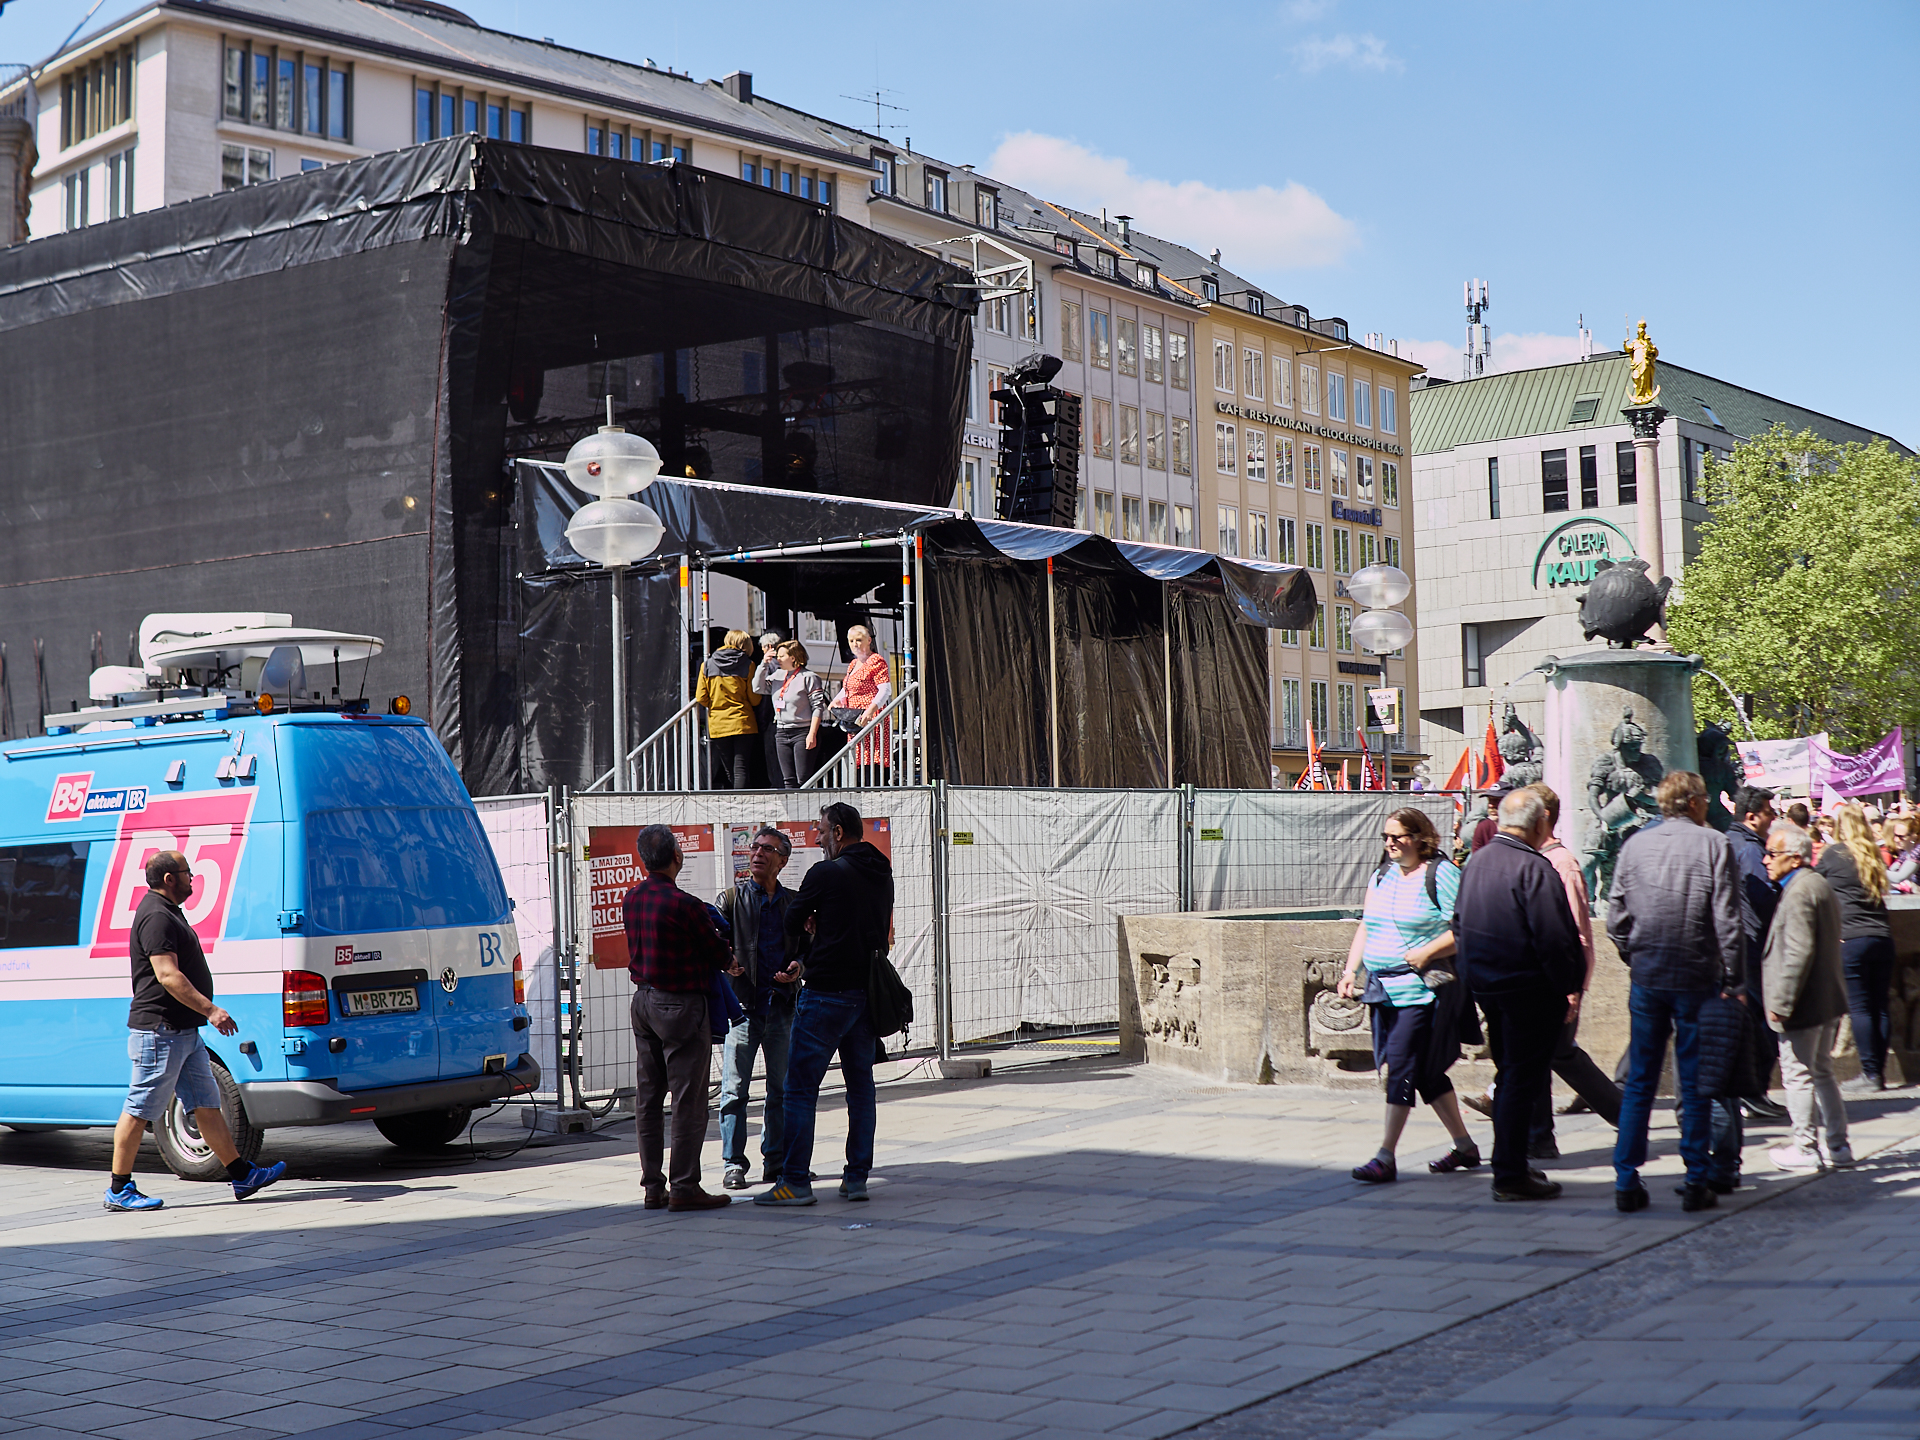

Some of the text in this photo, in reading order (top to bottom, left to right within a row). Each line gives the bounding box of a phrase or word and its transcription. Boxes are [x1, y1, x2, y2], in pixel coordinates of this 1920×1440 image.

[1249, 408, 1318, 435] RESTAURANT
[1319, 426, 1385, 452] GLOCKENSPIEL
[1387, 443, 1405, 456] BAR
[1557, 531, 1608, 554] GALERIA
[51, 781, 145, 813] B5 aktuell BR
[591, 856, 630, 868] 1. MAI 2019
[590, 866, 647, 887] EUROPA.
[590, 887, 628, 907] JETZT
[592, 907, 623, 926] RICH
[336, 948, 352, 963] B5
[354, 951, 371, 961] aktuell
[478, 932, 506, 967] BR
[353, 990, 414, 1011] M BR 725
